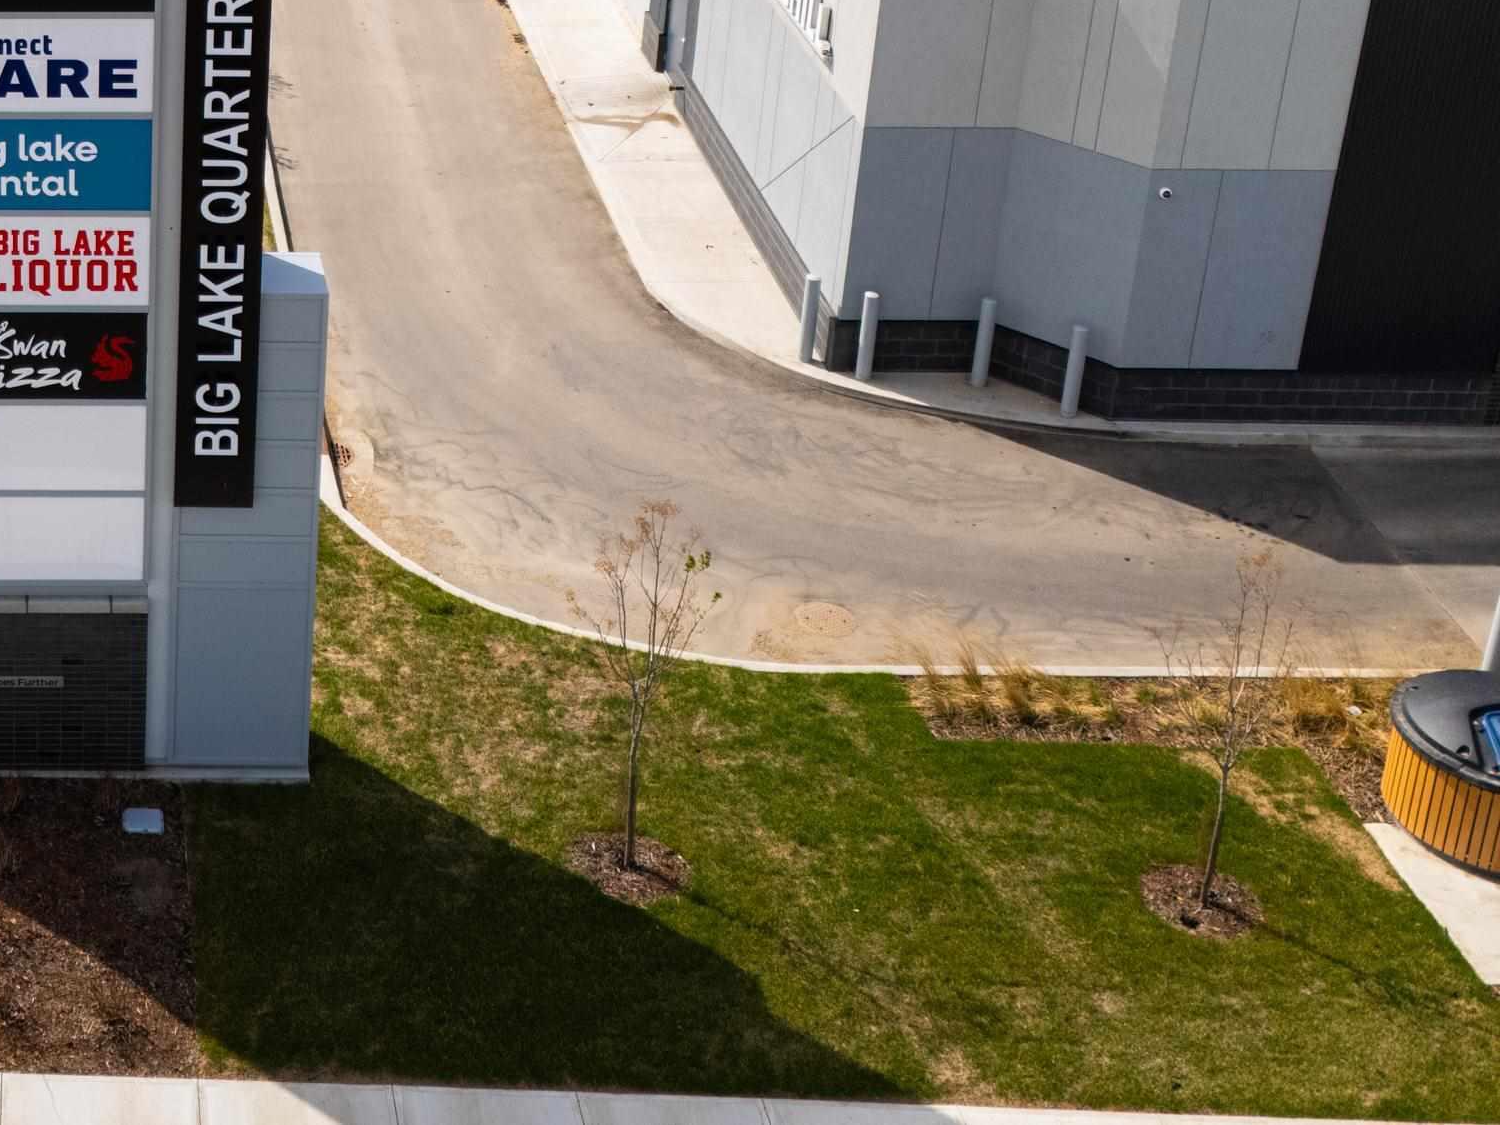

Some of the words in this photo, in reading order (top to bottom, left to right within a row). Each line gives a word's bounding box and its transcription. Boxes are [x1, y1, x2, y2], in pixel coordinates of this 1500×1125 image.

[18, 134, 98, 163] lake
[54, 230, 135, 256] LAKE
[197, 244, 245, 362] LAKE
[194, 382, 240, 457] BIG
